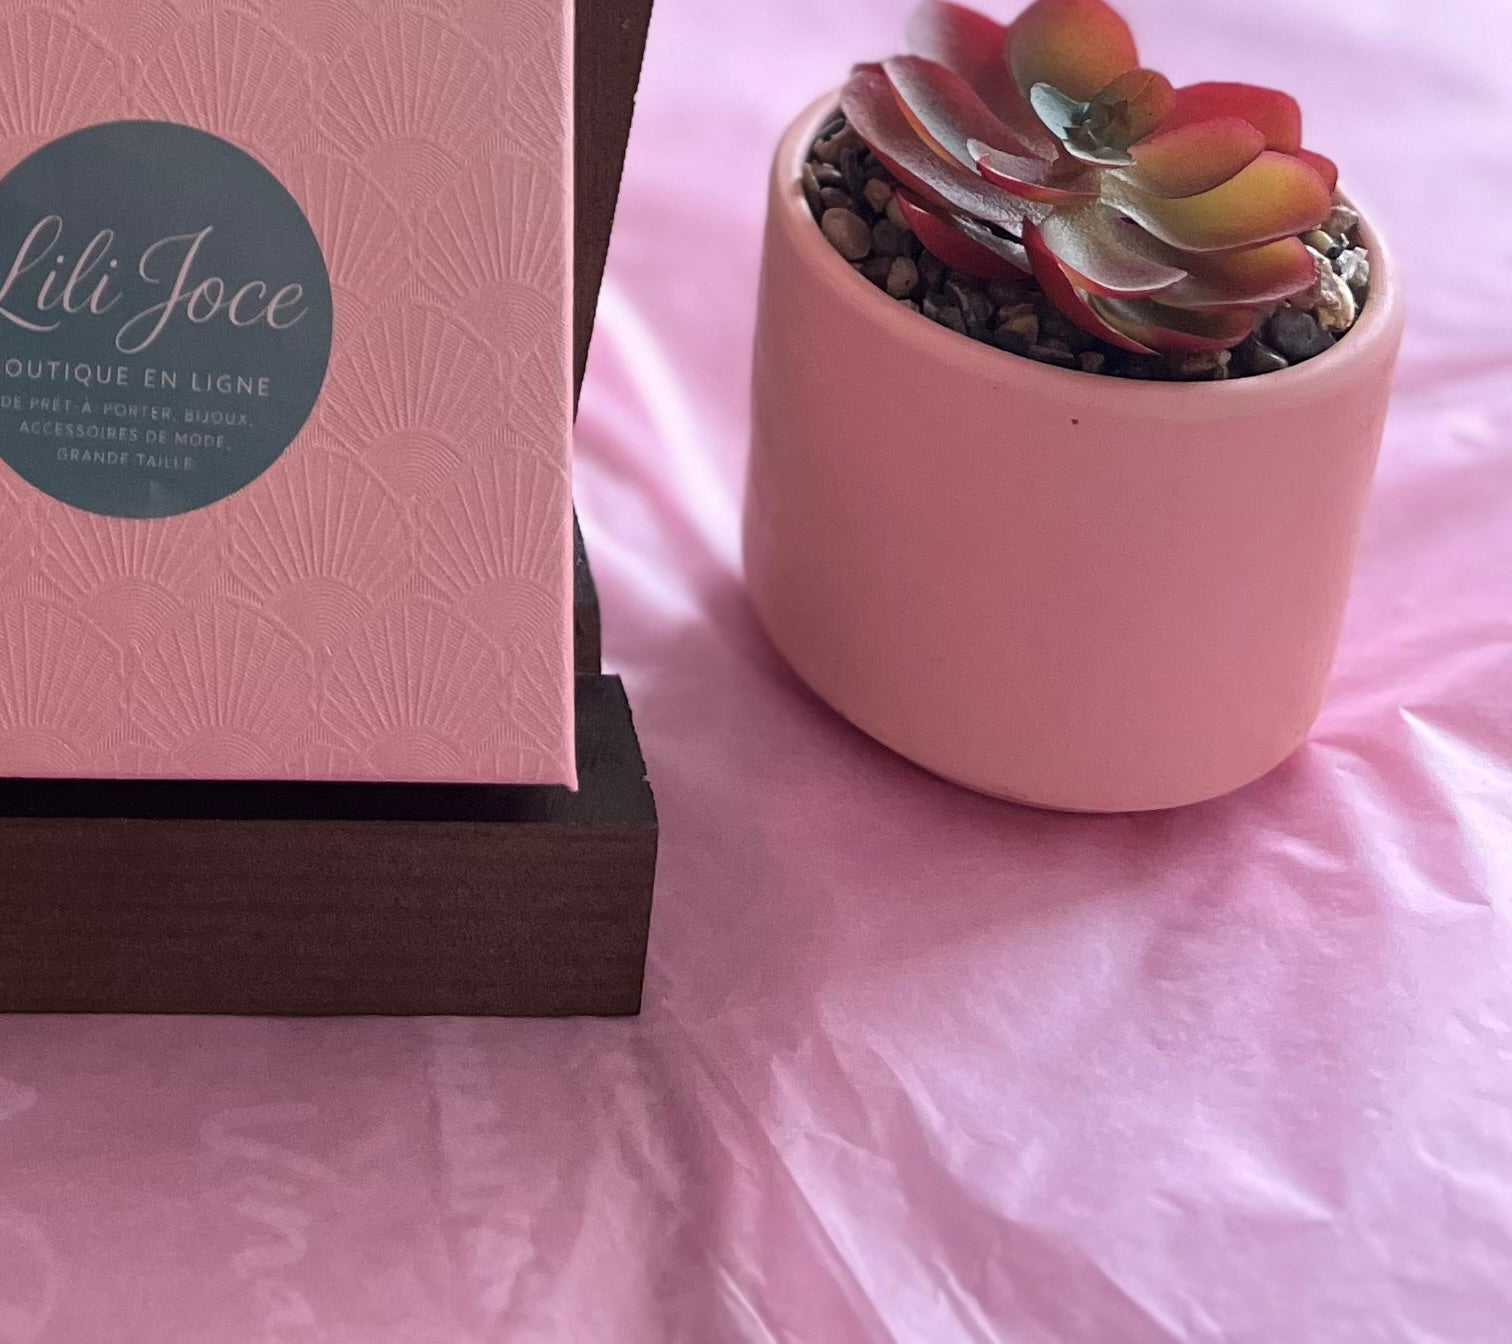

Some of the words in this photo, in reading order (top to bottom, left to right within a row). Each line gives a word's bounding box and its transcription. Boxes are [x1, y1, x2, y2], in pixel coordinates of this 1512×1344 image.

[114, 225, 309, 354] Joce
[143, 368, 178, 389] EN
[190, 373, 271, 397] LIGNE
[0, 395, 22, 409] DE
[19, 420, 138, 441] ACCESSOIRES
[145, 429, 167, 443] DE
[56, 447, 129, 464] GRANDE
[136, 452, 192, 470] TAILLE
